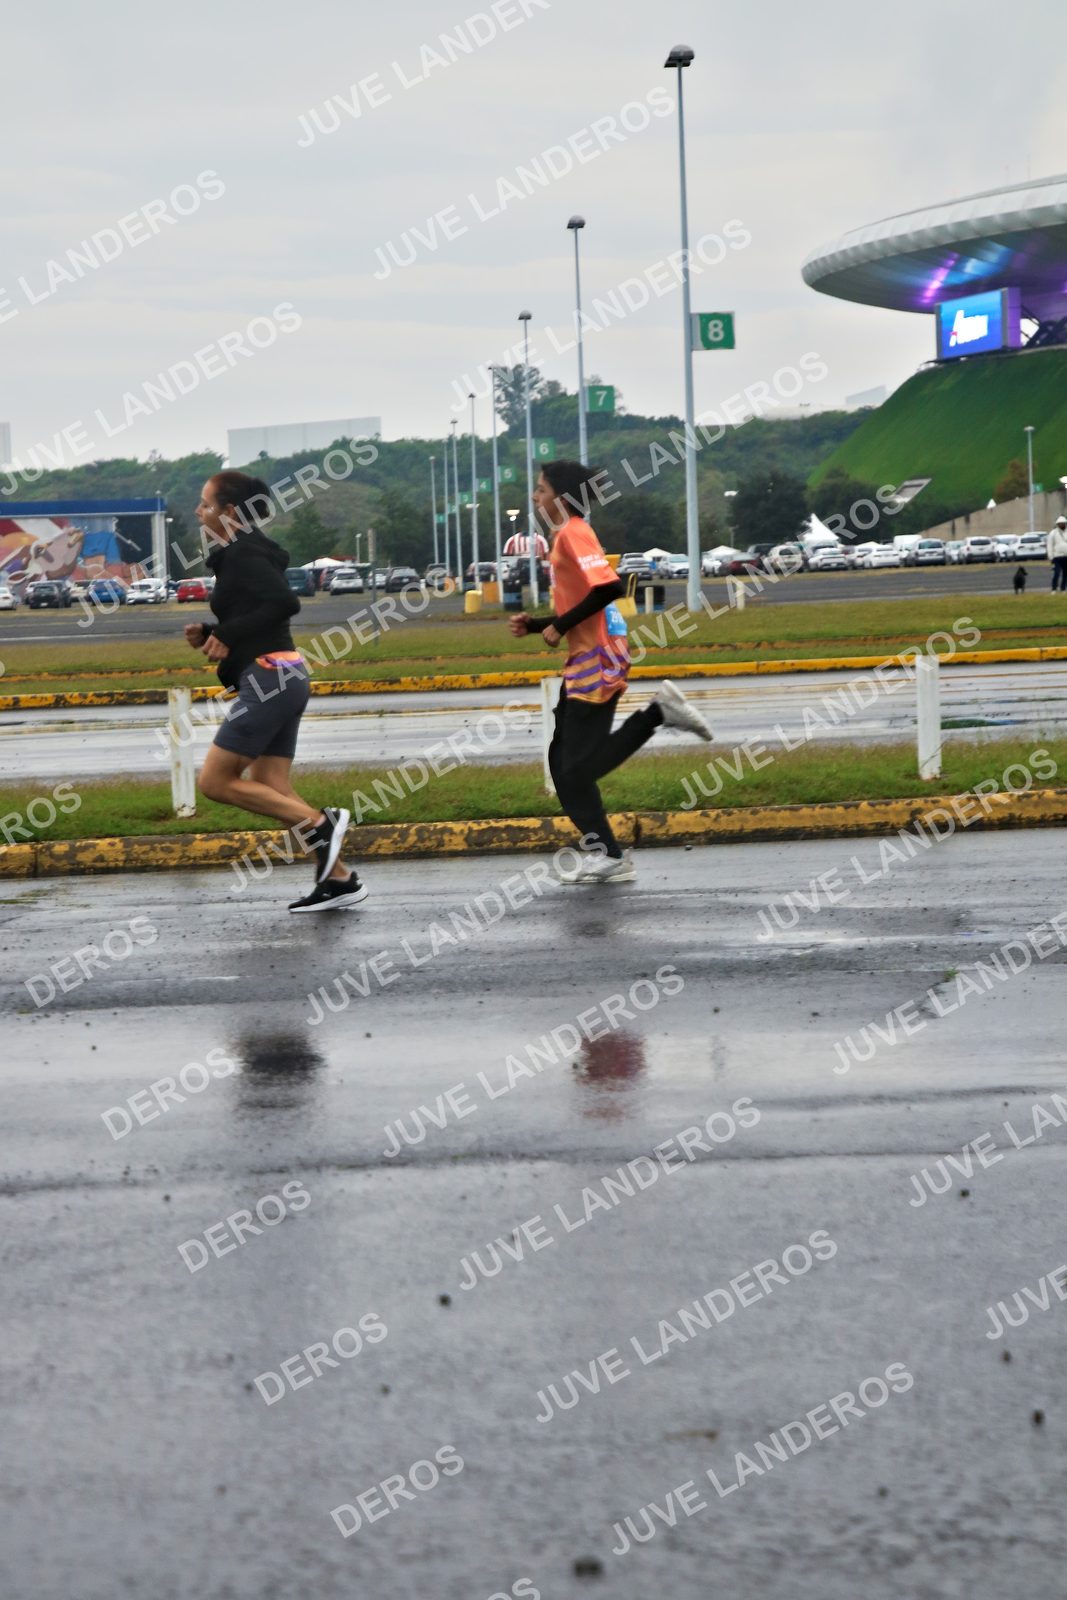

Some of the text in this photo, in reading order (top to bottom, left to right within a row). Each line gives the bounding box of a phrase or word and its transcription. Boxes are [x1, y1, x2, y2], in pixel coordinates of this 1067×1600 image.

[707, 319, 724, 341] 8
[596, 391, 607, 407] 7
[539, 443, 549, 455] 6
[504, 468, 512, 479] 5
[480, 481, 487, 489] 4
